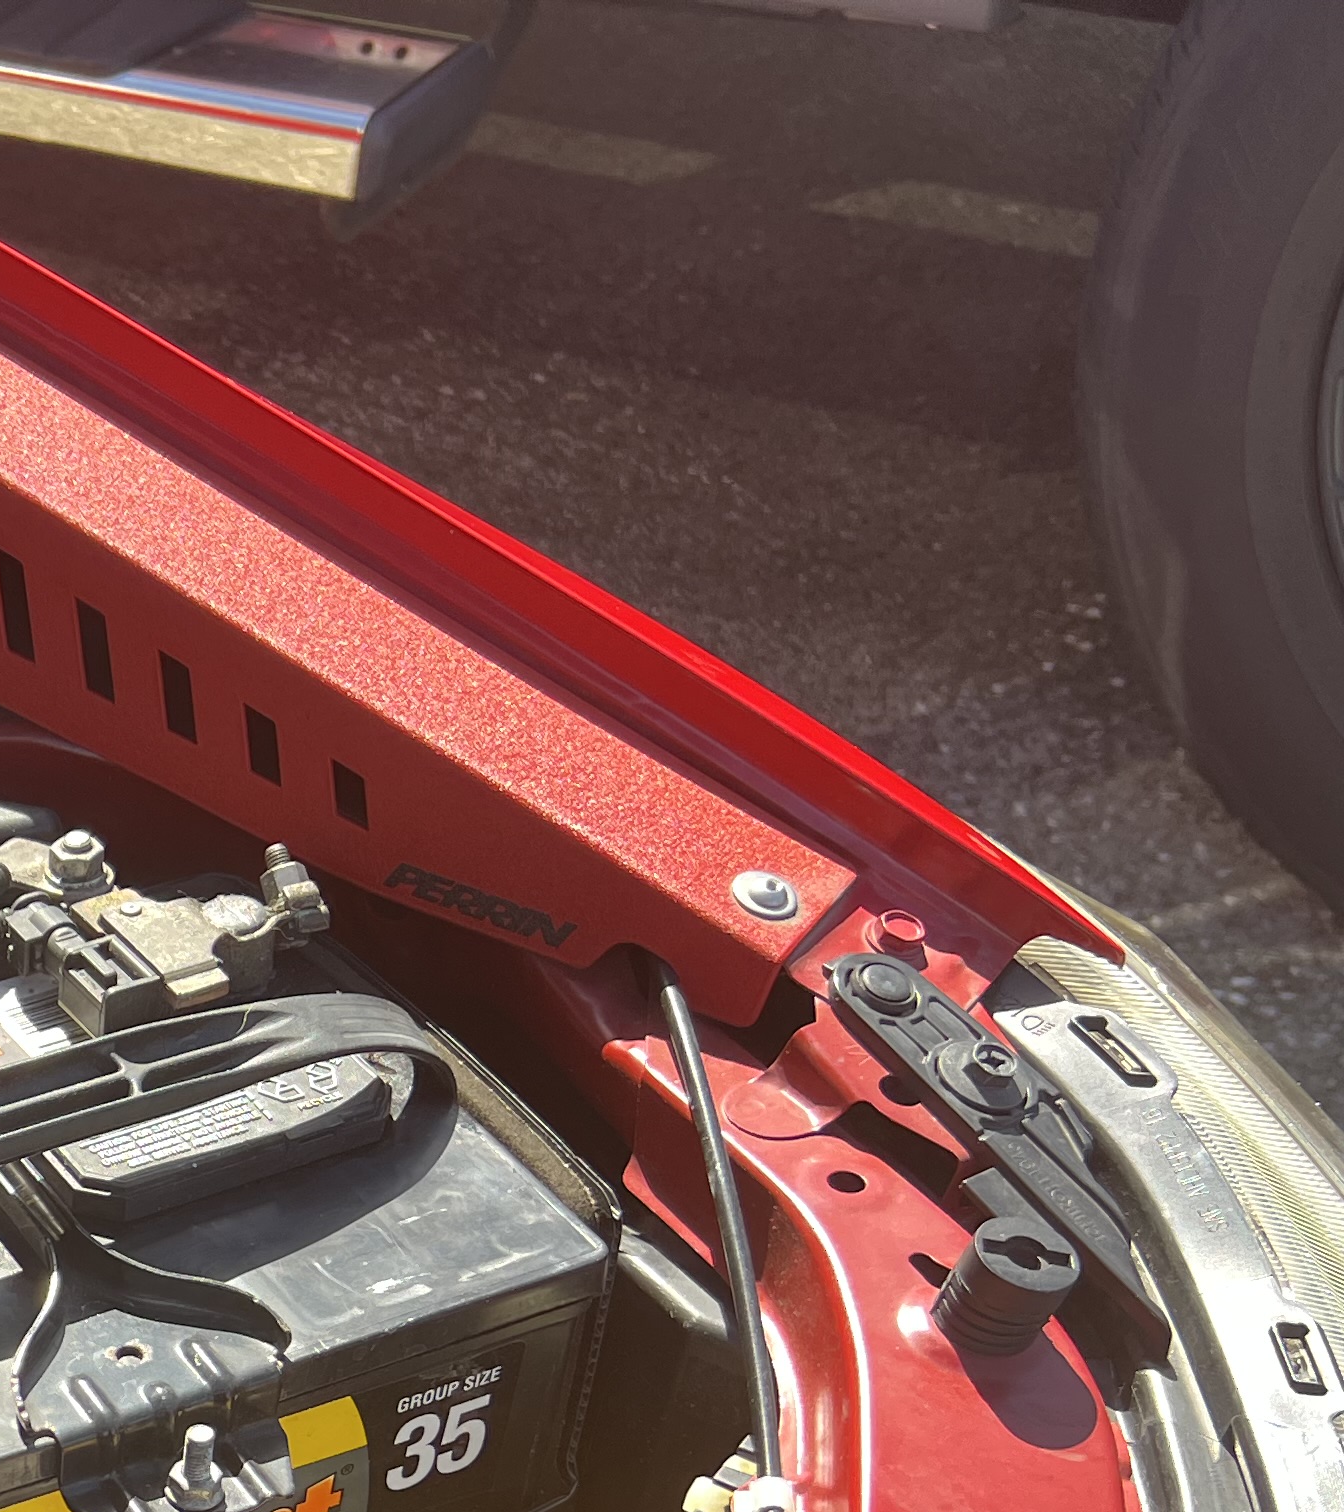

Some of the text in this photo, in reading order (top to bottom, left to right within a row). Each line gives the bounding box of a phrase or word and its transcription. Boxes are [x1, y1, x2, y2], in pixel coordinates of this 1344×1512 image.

[383, 863, 578, 948] PERRIN
[397, 1365, 502, 1414] GROUP SIZE
[386, 1393, 492, 1491] 35
